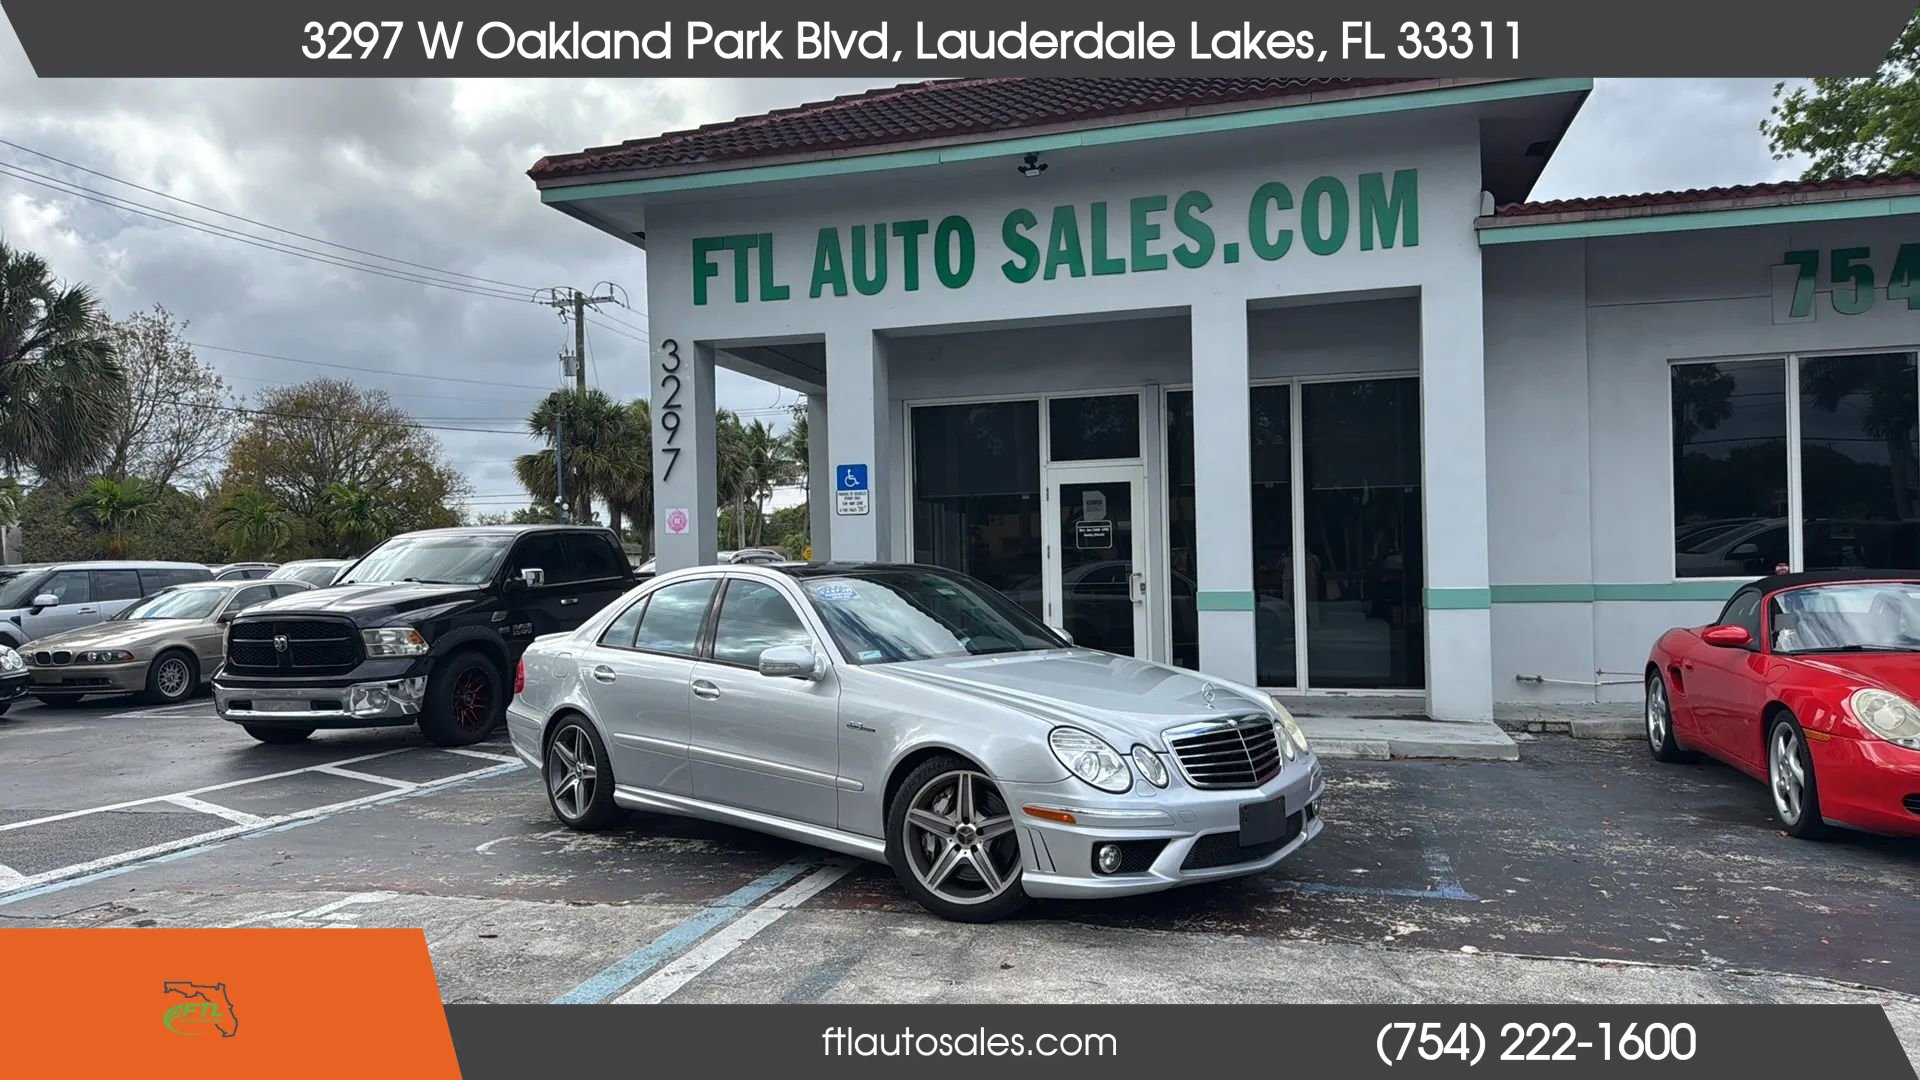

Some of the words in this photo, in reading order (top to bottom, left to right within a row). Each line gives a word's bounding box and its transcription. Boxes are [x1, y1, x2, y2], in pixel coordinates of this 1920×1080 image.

[692, 232, 790, 305] FTL
[809, 215, 975, 298] AUTO
[1001, 168, 1419, 284] SALES.COM
[1784, 243, 1920, 317] 754
[661, 338, 682, 482] 3297
